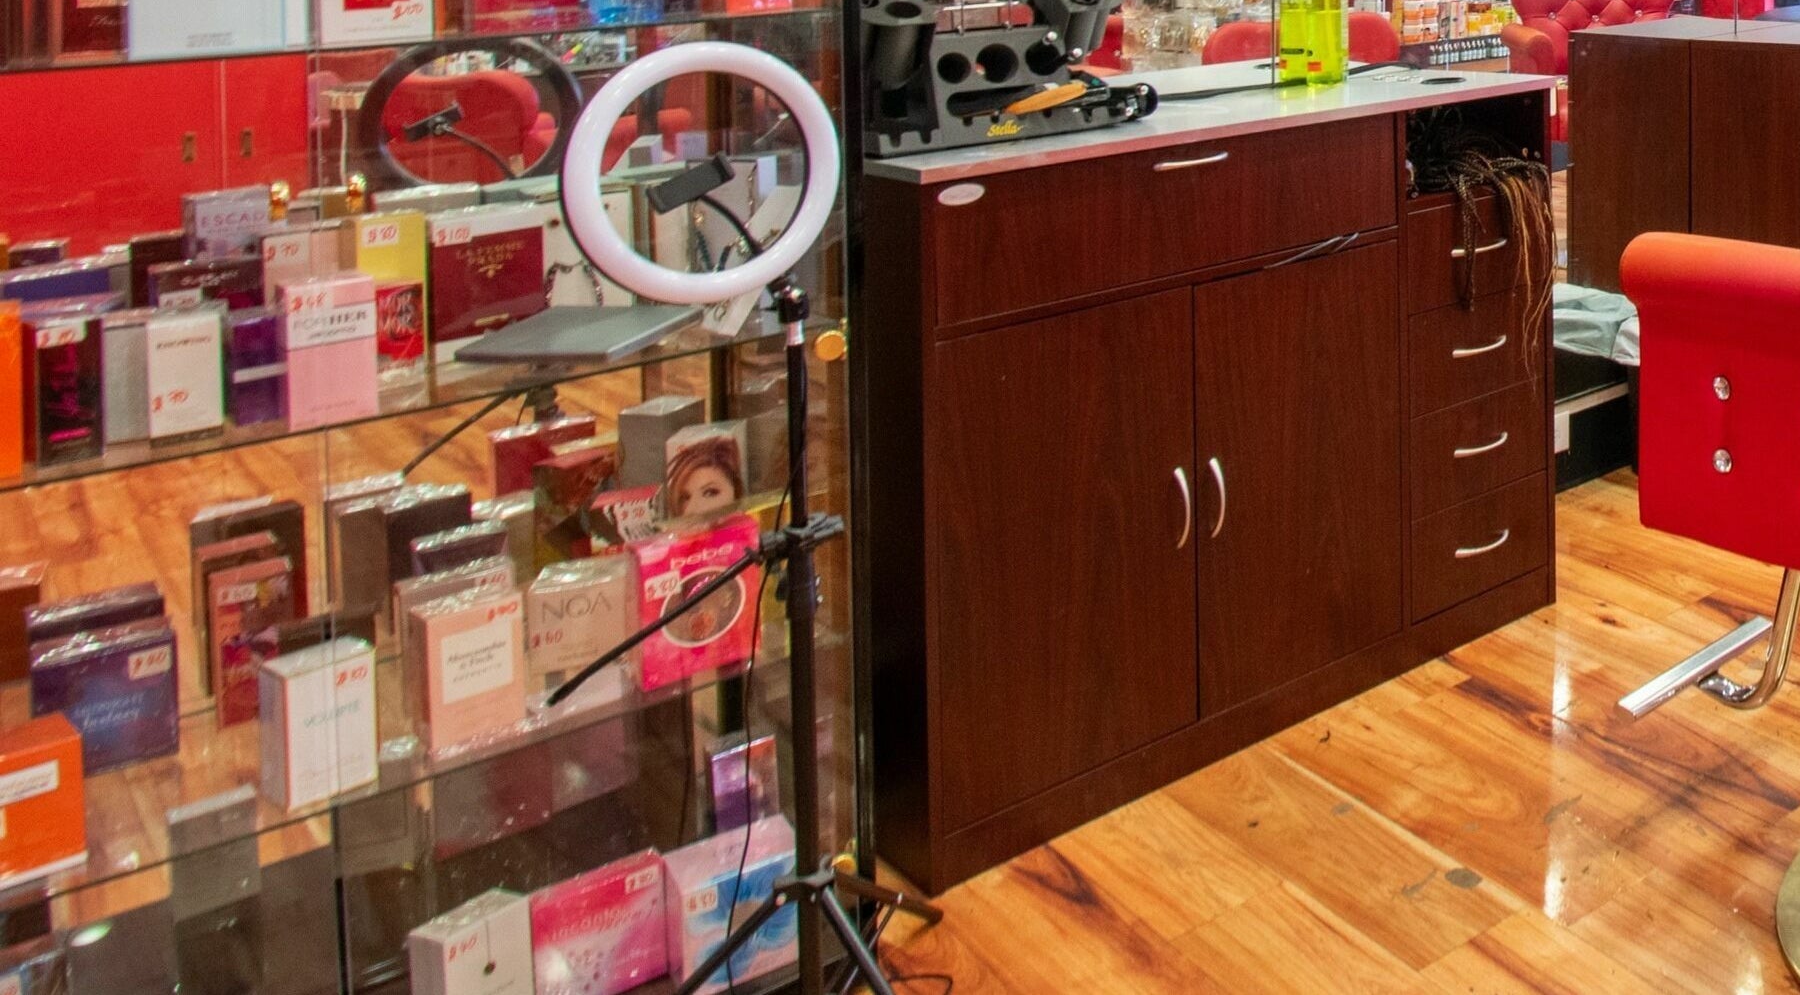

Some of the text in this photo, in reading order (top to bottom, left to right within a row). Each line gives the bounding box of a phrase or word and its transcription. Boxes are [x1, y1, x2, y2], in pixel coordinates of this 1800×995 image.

[986, 118, 1023, 138] Stella
[200, 211, 266, 228] ESCAD
[669, 542, 735, 572] bebe
[541, 591, 614, 624] NOA
